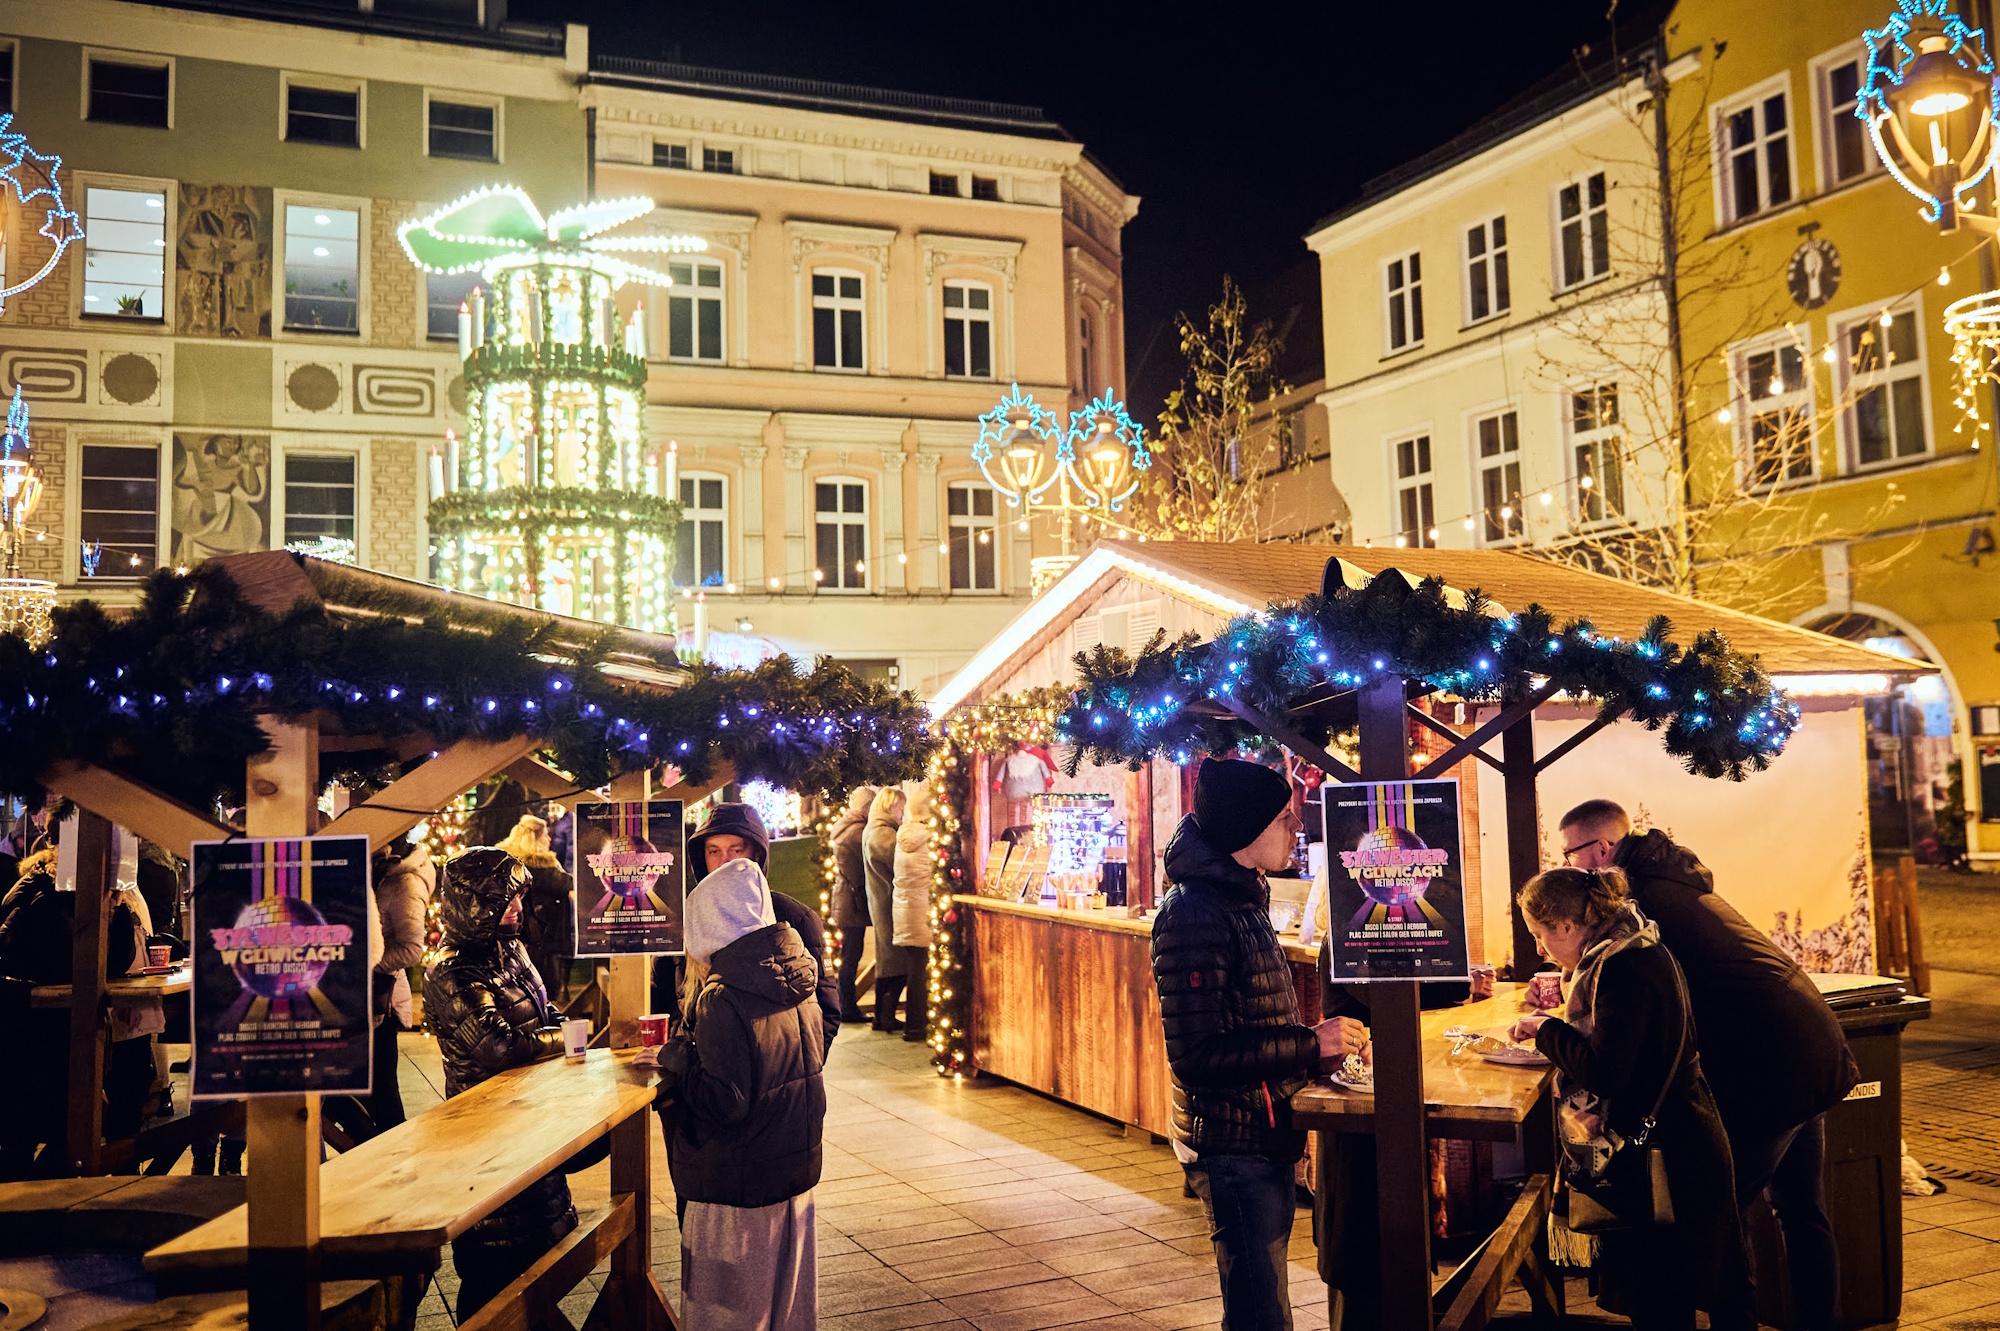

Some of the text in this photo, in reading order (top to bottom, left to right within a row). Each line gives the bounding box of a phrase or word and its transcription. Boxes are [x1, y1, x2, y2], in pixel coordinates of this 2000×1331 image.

[1340, 849, 1448, 868] SYLWESTER
[605, 865, 669, 877] GLIWICACH
[1348, 865, 1443, 879] W GLIWICACH
[614, 875, 631, 883] RETRO
[1374, 877, 1415, 888] RETRO DISCO
[1365, 923, 1379, 931] DISCO
[1407, 922, 1427, 930] AEROBIK
[1349, 931, 1361, 939] PLAC
[1399, 930, 1410, 938] GIER
[1411, 930, 1425, 938] VIDEO
[221, 946, 345, 965] W GLIWICACH
[1848, 1084, 1876, 1097] ONDIS
